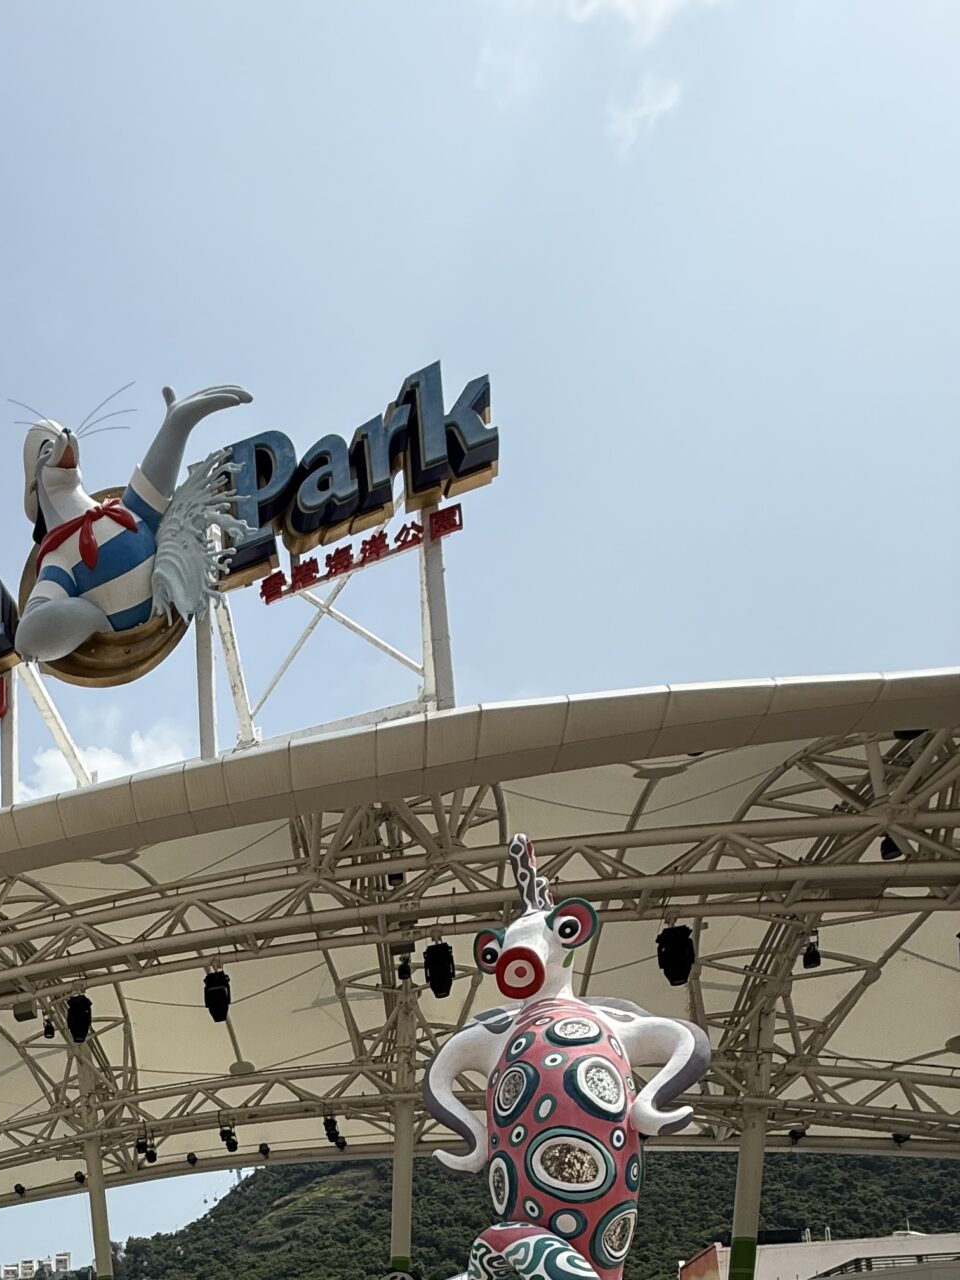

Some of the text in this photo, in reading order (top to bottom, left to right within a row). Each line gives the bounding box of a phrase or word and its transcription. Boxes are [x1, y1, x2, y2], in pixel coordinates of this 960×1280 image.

[216, 360, 499, 583] Park
[260, 503, 463, 605] 香港海洋公園
